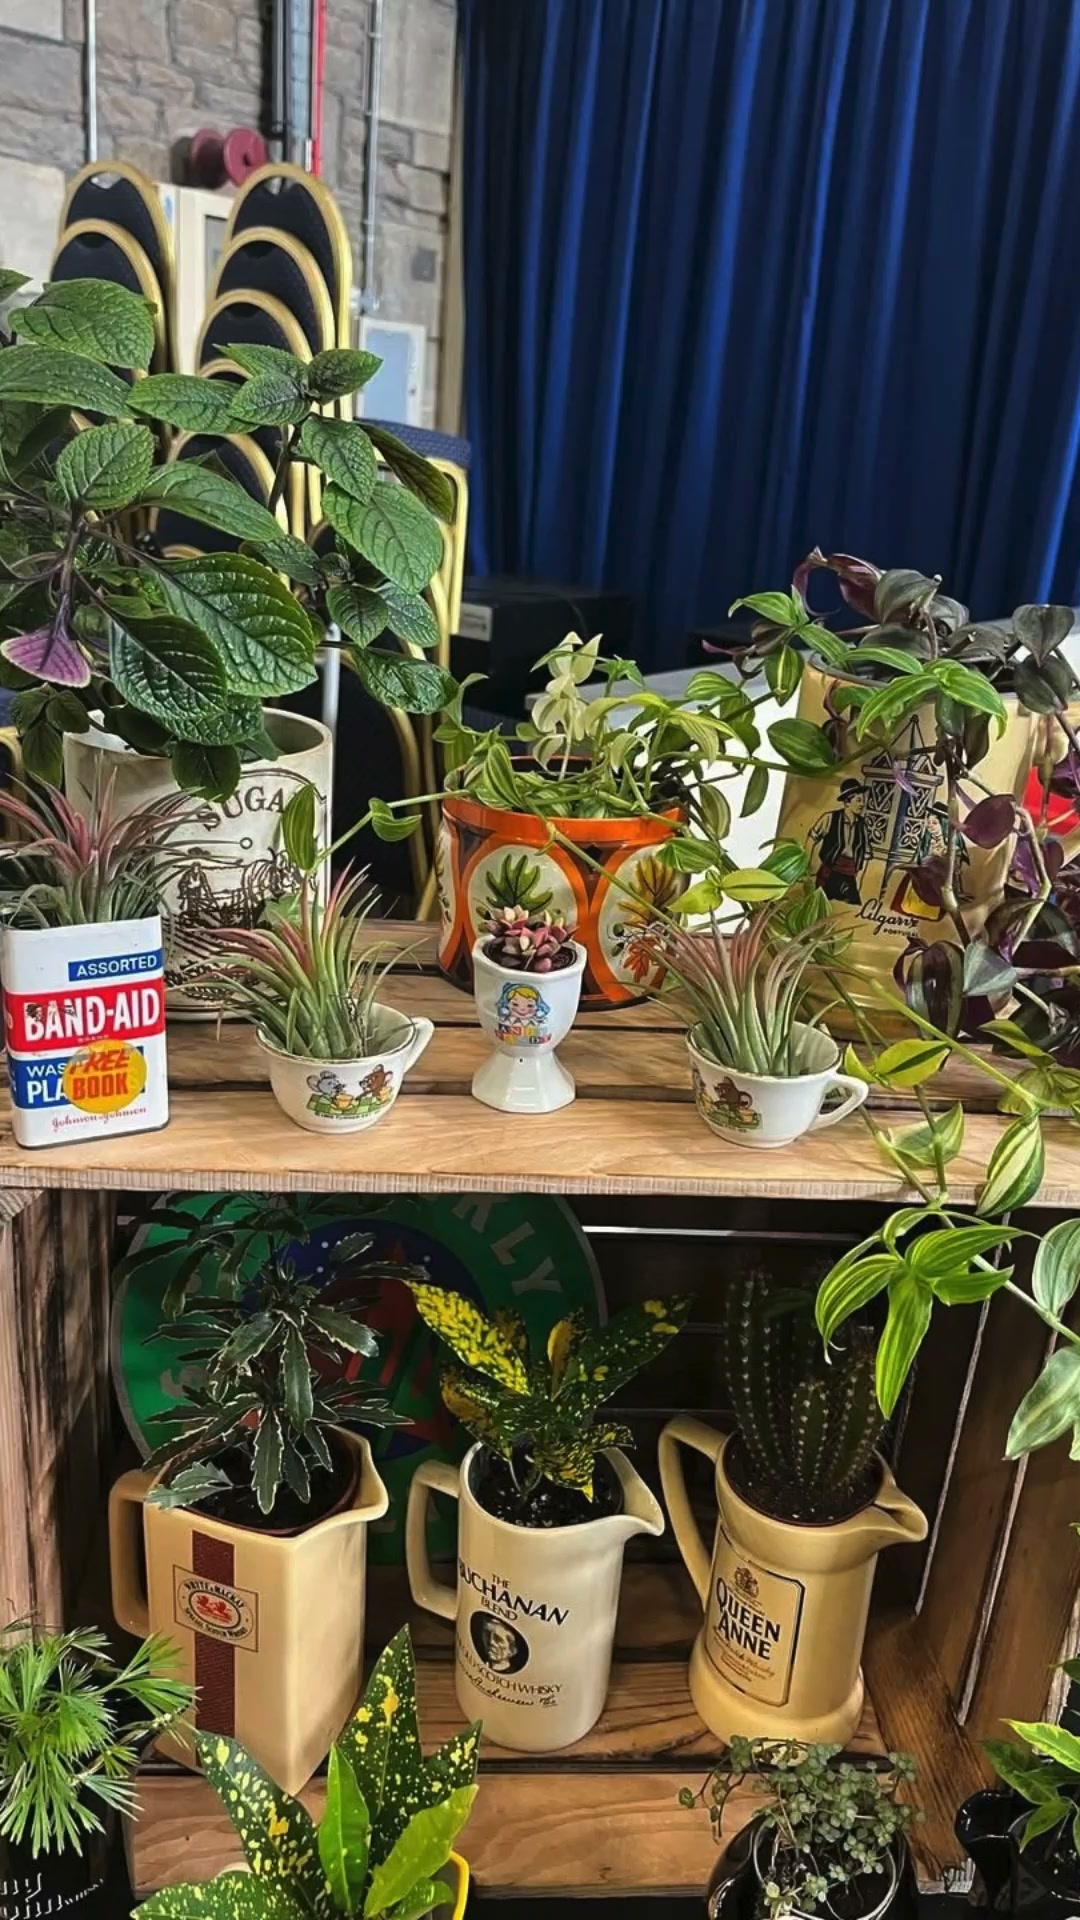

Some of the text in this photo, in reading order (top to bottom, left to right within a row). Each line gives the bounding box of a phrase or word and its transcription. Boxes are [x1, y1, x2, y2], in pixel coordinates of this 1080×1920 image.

[197, 786, 286, 832] SUGA
[76, 955, 157, 977] ASSORTED
[23, 988, 160, 1042] BAND-AID
[27, 1063, 65, 1078] WAS
[69, 1048, 130, 1075] FREE
[27, 1079, 68, 1104] PLA
[72, 1072, 129, 1100] BOOK
[492, 1573, 511, 1589] THE
[481, 1596, 518, 1621] BLEND
[716, 1577, 781, 1642] QUEEN
[718, 1611, 772, 1660] ANNE
[518, 1683, 563, 1694] WHISKY
